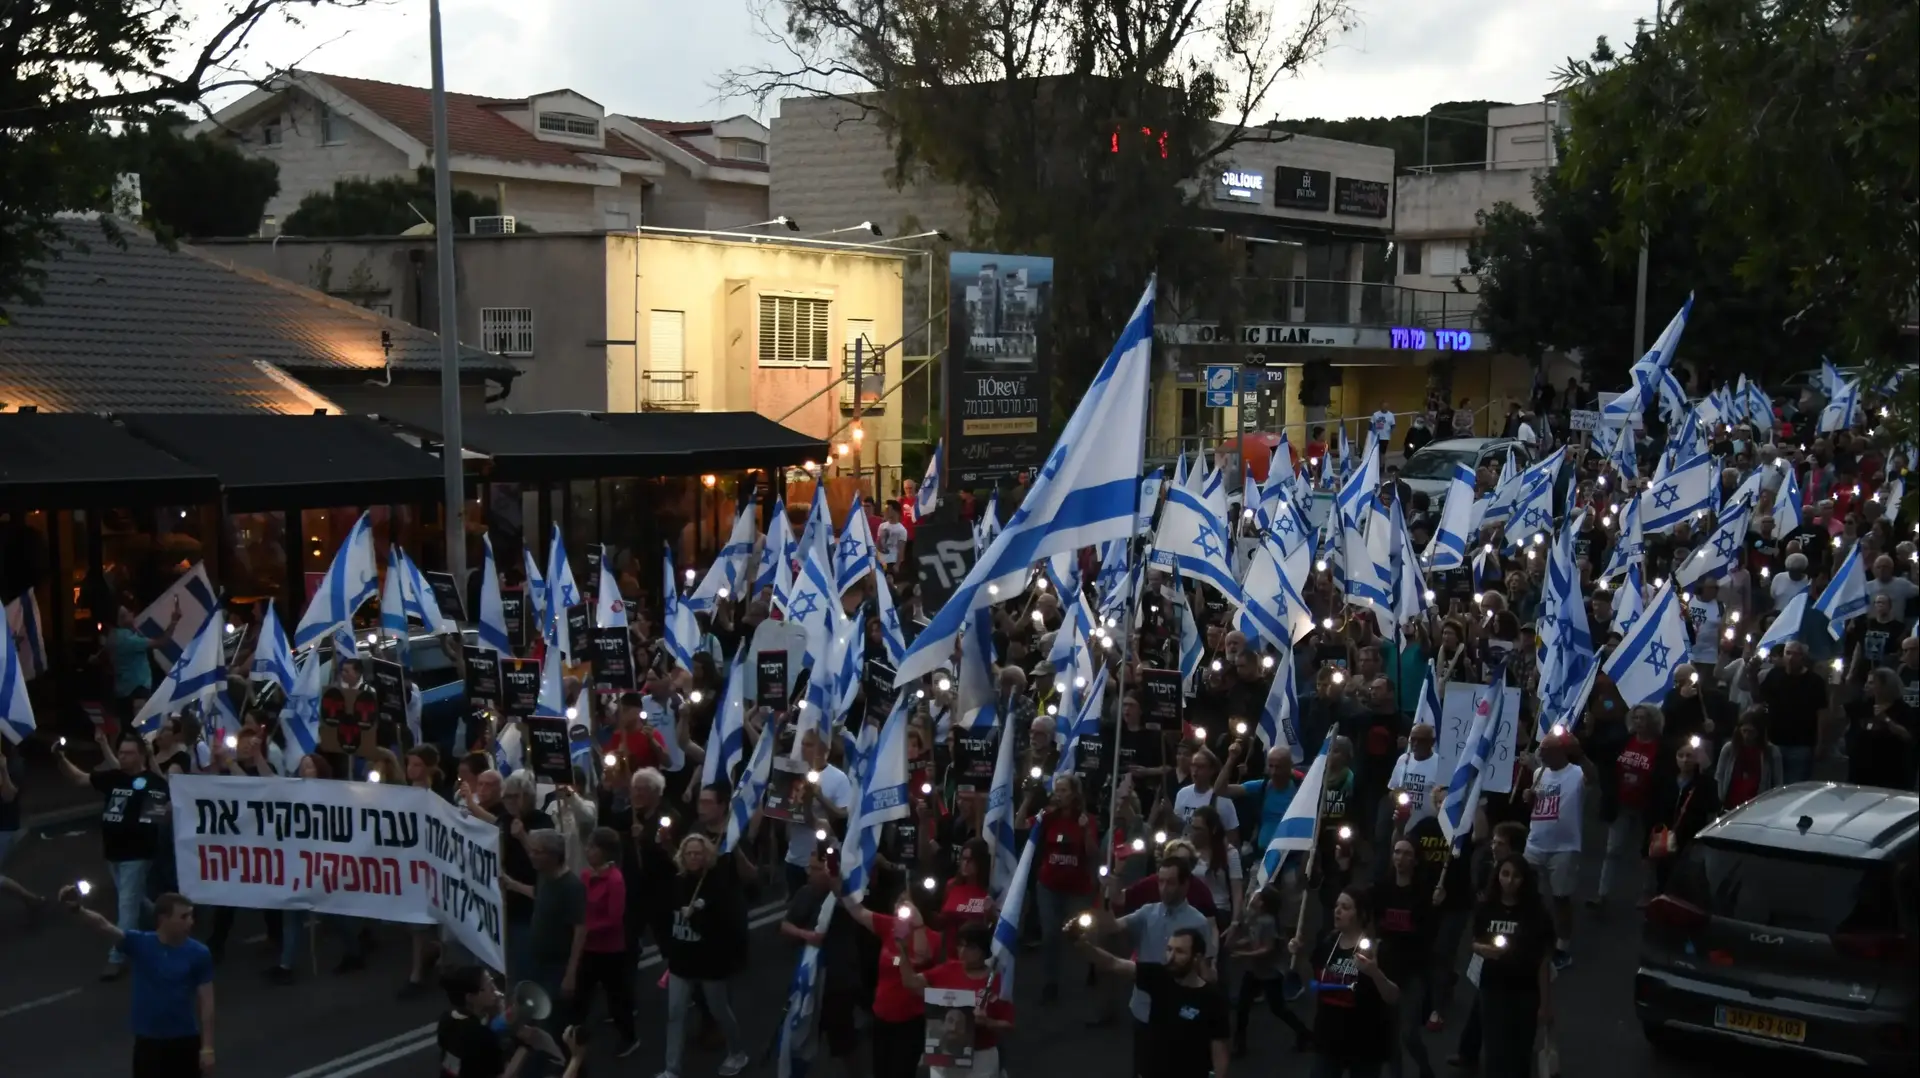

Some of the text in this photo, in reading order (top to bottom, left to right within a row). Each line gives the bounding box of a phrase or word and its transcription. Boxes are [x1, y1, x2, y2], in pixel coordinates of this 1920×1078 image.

[1266, 327, 1310, 343] ILAN
[1435, 330, 1471, 350] פריד
[195, 799, 241, 835] את
[247, 801, 353, 843] שהפקיד
[361, 809, 418, 847] עברי
[199, 844, 284, 886] נתניהו
[293, 851, 402, 895] המפקיר,
